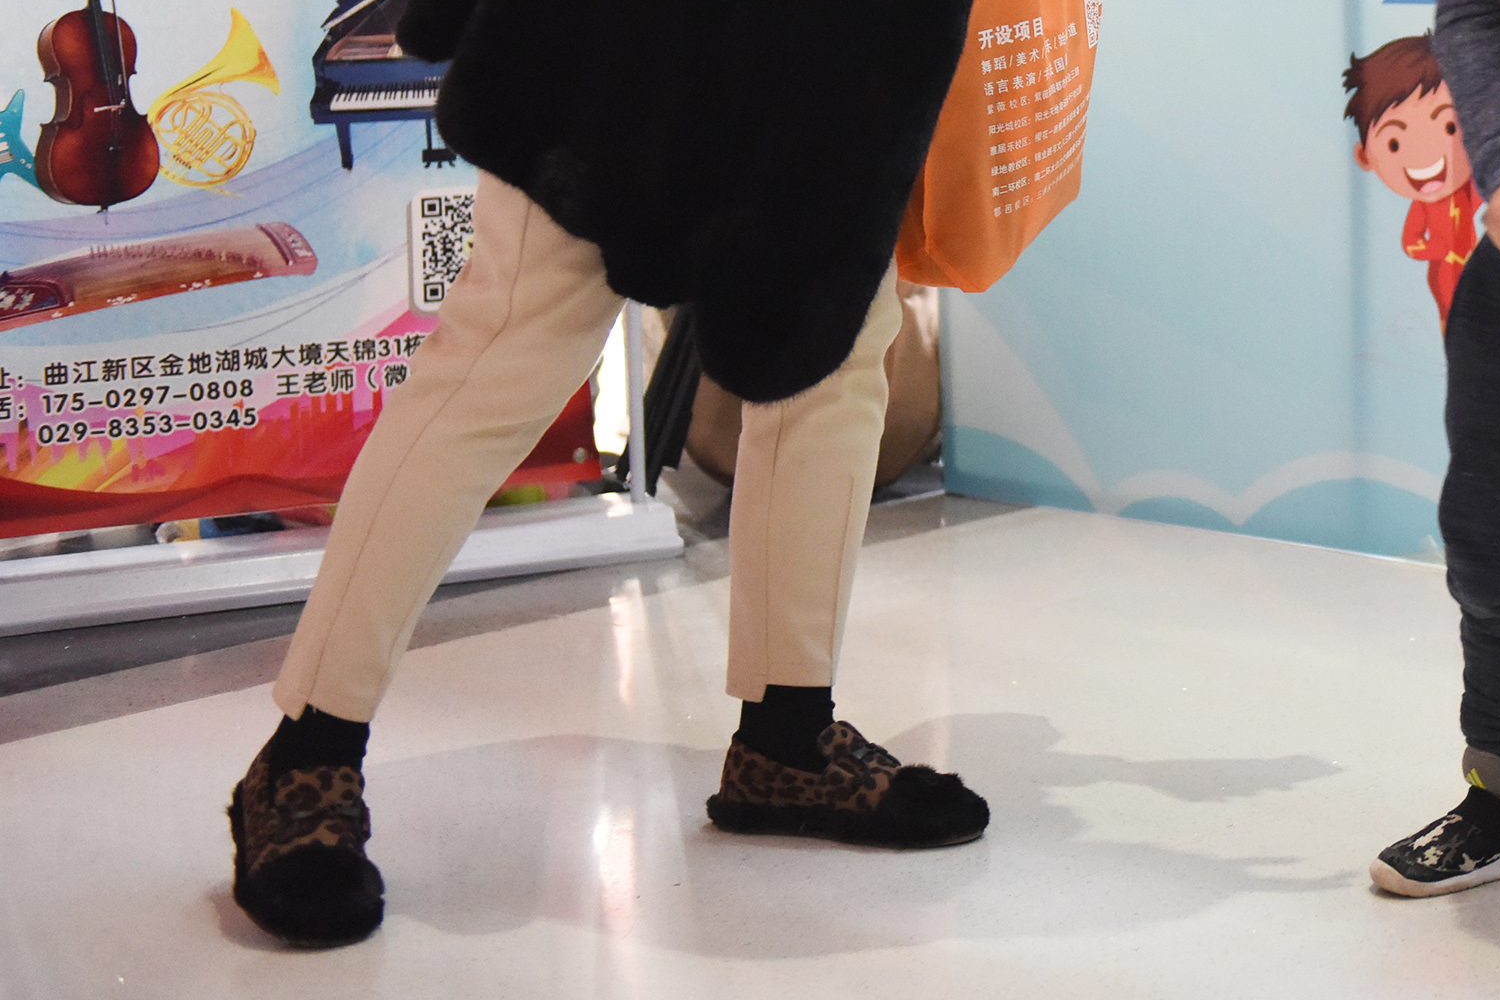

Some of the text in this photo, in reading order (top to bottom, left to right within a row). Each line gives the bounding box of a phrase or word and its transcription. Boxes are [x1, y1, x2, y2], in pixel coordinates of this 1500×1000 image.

[978, 17, 1044, 51] 开设项目
[38, 407, 257, 445] 029-8353-0345
